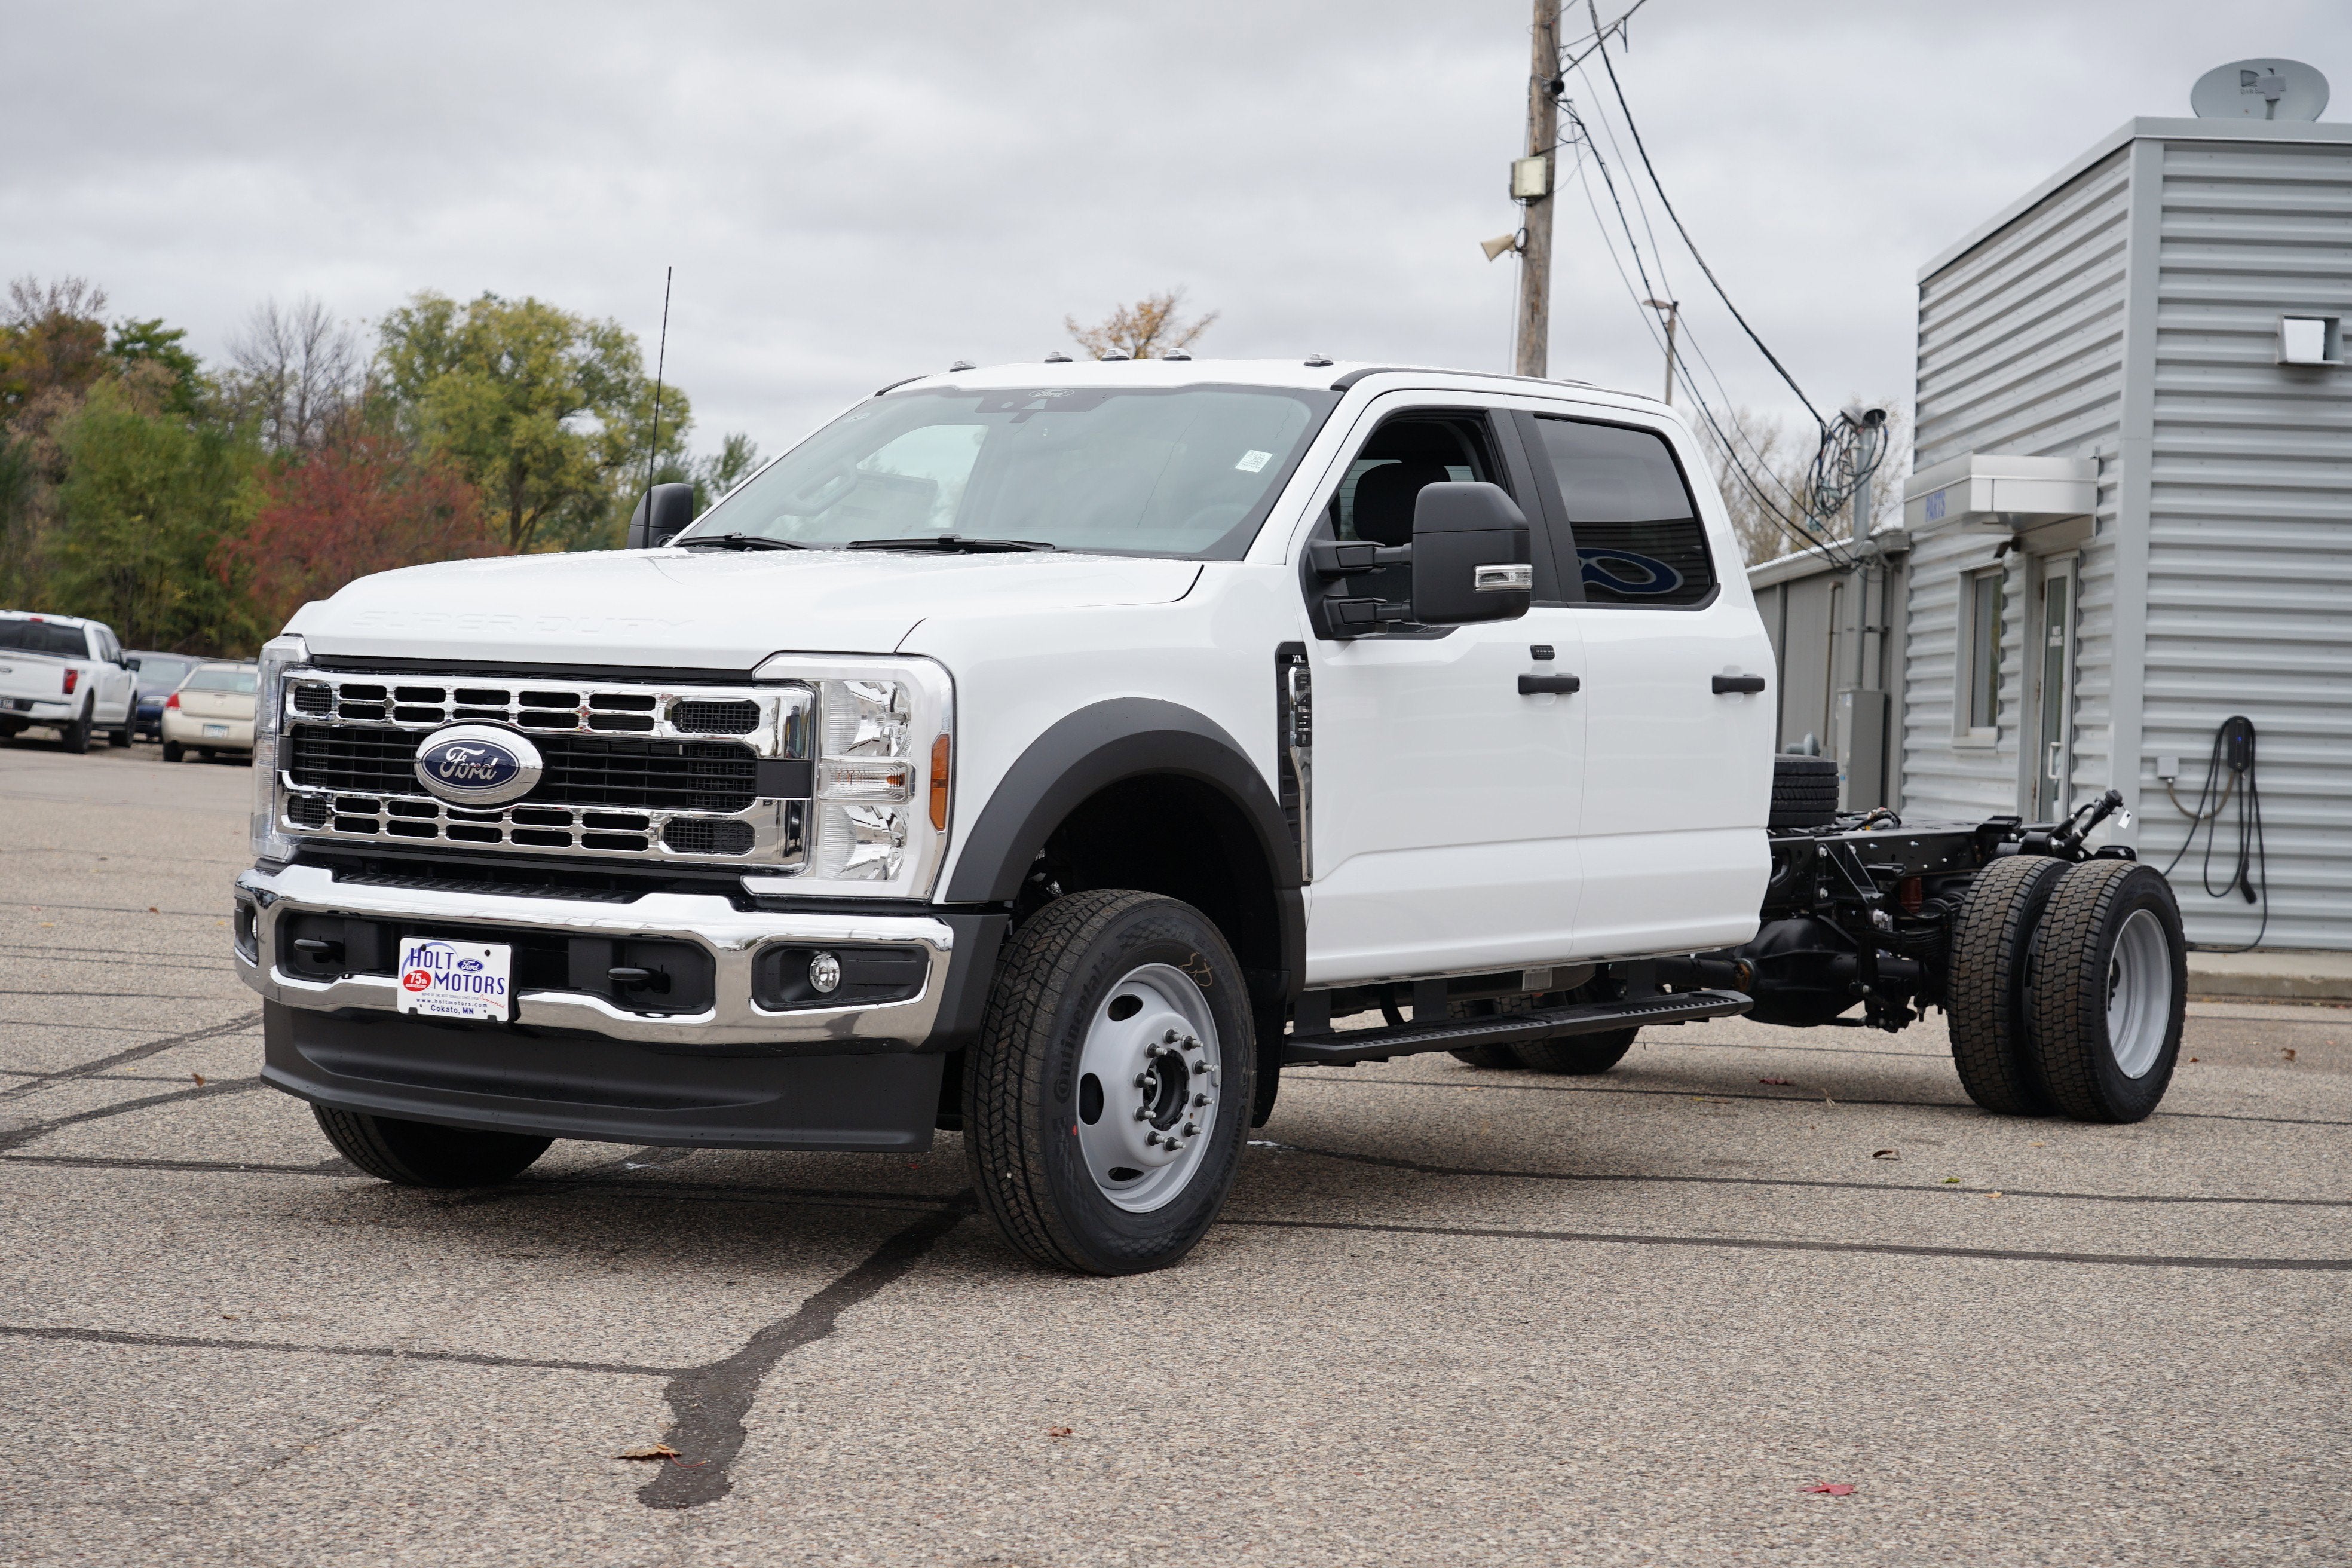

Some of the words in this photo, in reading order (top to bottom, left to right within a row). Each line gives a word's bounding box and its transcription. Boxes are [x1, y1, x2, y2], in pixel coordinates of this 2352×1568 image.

[349, 610, 523, 634] SUPER
[529, 615, 696, 638] DUTY
[1291, 654, 1306, 663] XL
[439, 746, 499, 780] Ford
[409, 947, 454, 970] HOLT
[461, 960, 479, 971] Ford
[434, 970, 505, 995] MOTORS
[416, 997, 488, 1008] www.holtmotors.com
[431, 1004, 460, 1015] Cokato,
[1054, 964, 1104, 1104] Continental
